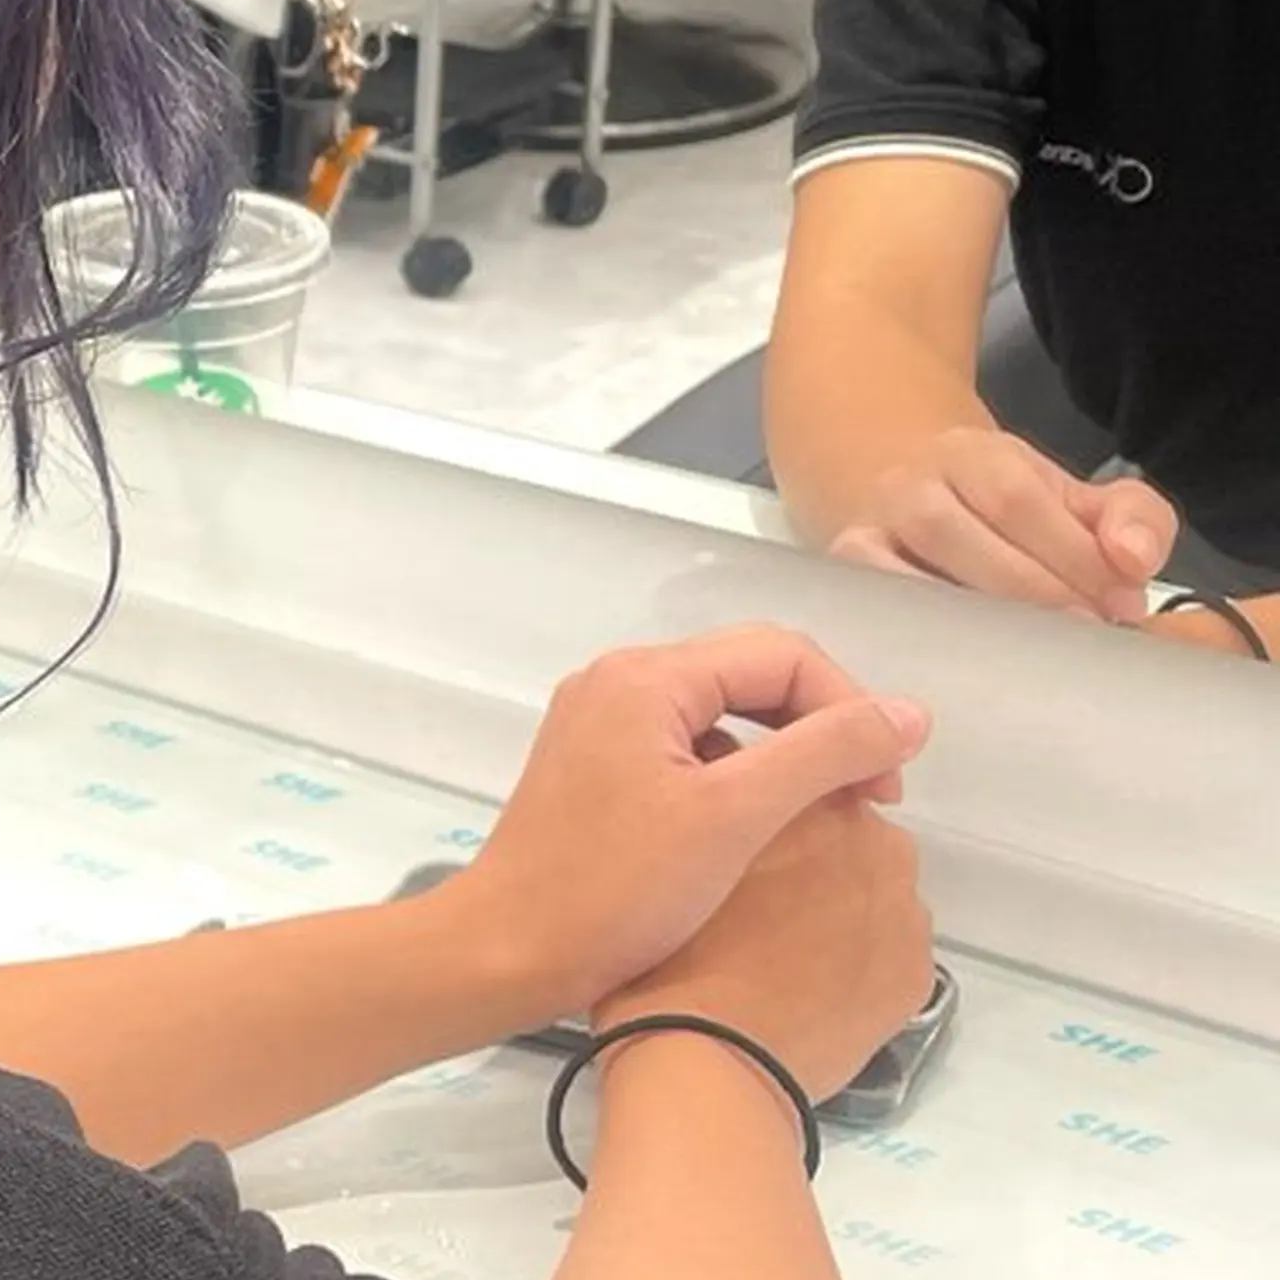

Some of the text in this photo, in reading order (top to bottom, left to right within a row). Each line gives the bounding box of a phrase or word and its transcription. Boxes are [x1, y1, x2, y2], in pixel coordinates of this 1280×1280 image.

[1047, 1022, 1161, 1065] SHE
[1057, 1111, 1171, 1157] SHE
[832, 1218, 945, 1268] SHE
[1066, 1207, 1187, 1256] SHE
